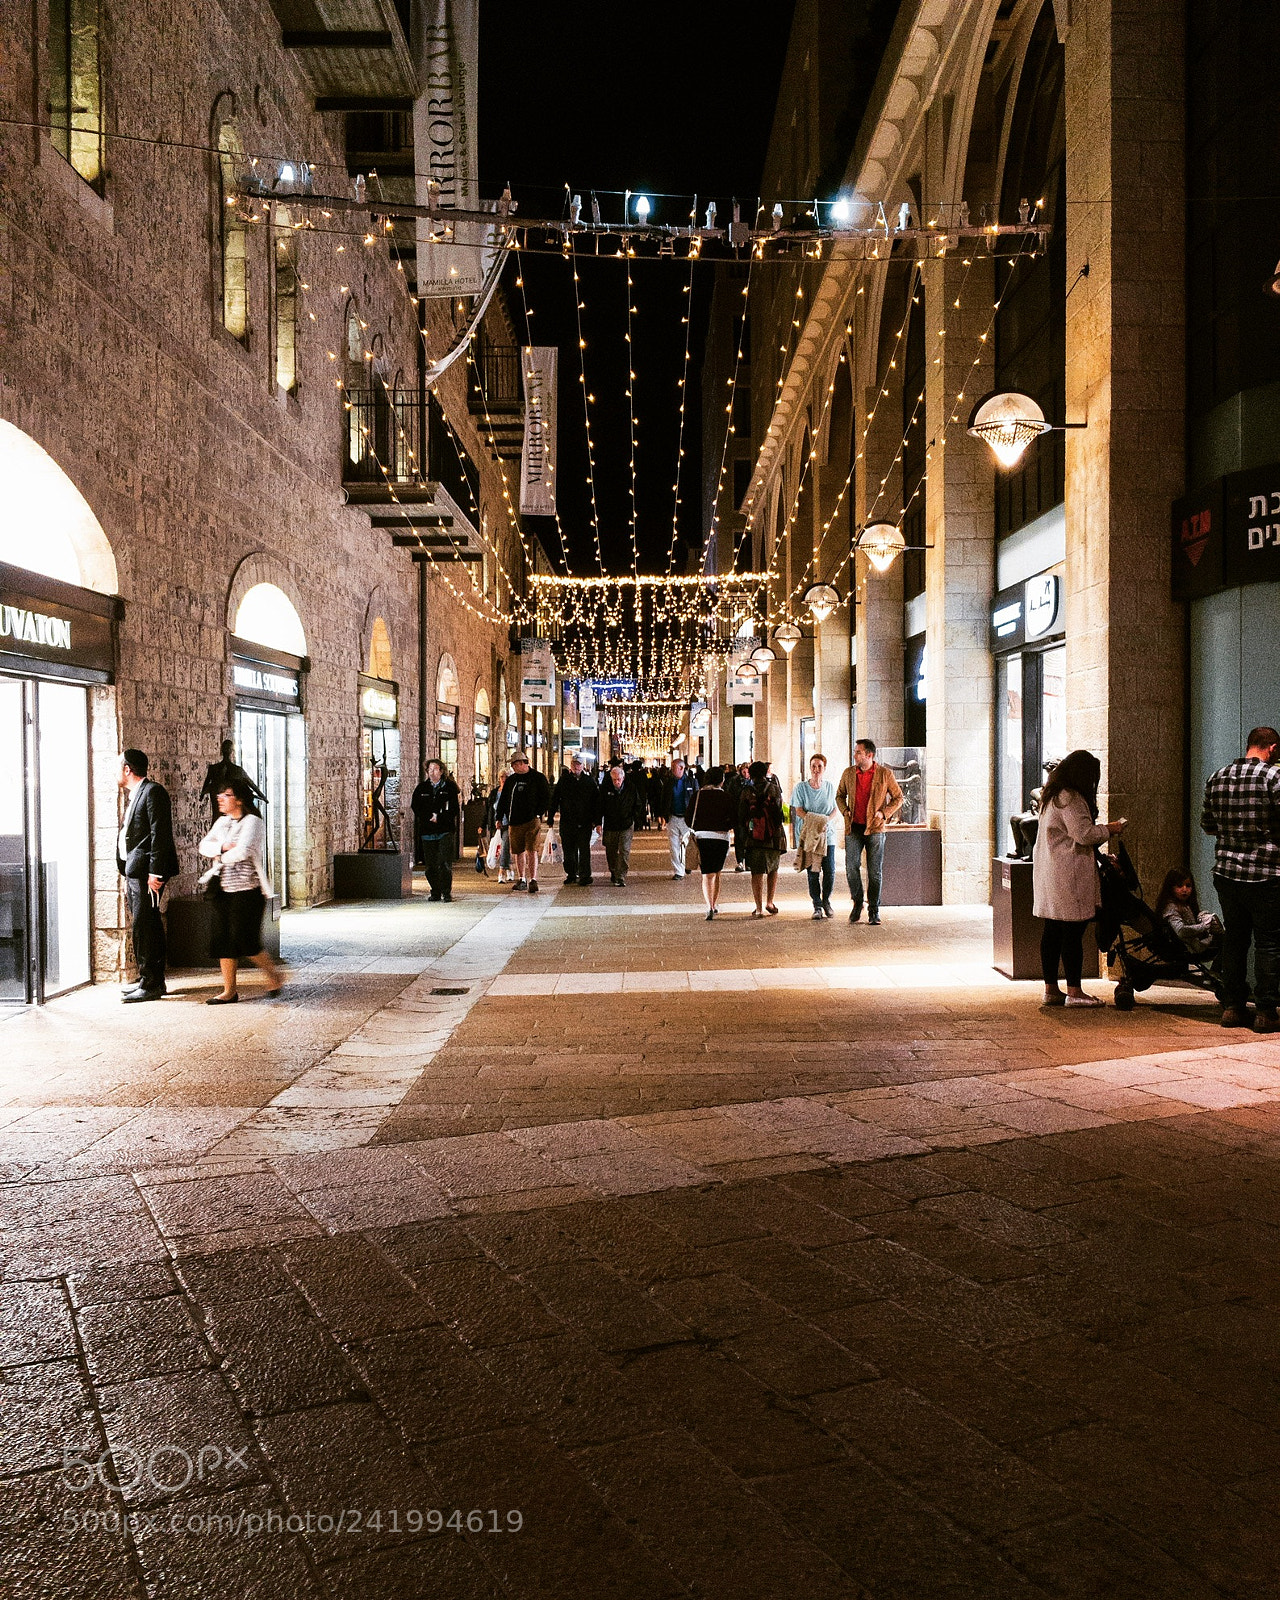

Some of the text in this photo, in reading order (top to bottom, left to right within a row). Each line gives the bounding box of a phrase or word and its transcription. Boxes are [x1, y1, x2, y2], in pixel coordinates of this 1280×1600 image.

[457, 61, 468, 107] Lounge
[458, 111, 468, 144] Cigar
[422, 277, 478, 287] MAMILLA HOTEL
